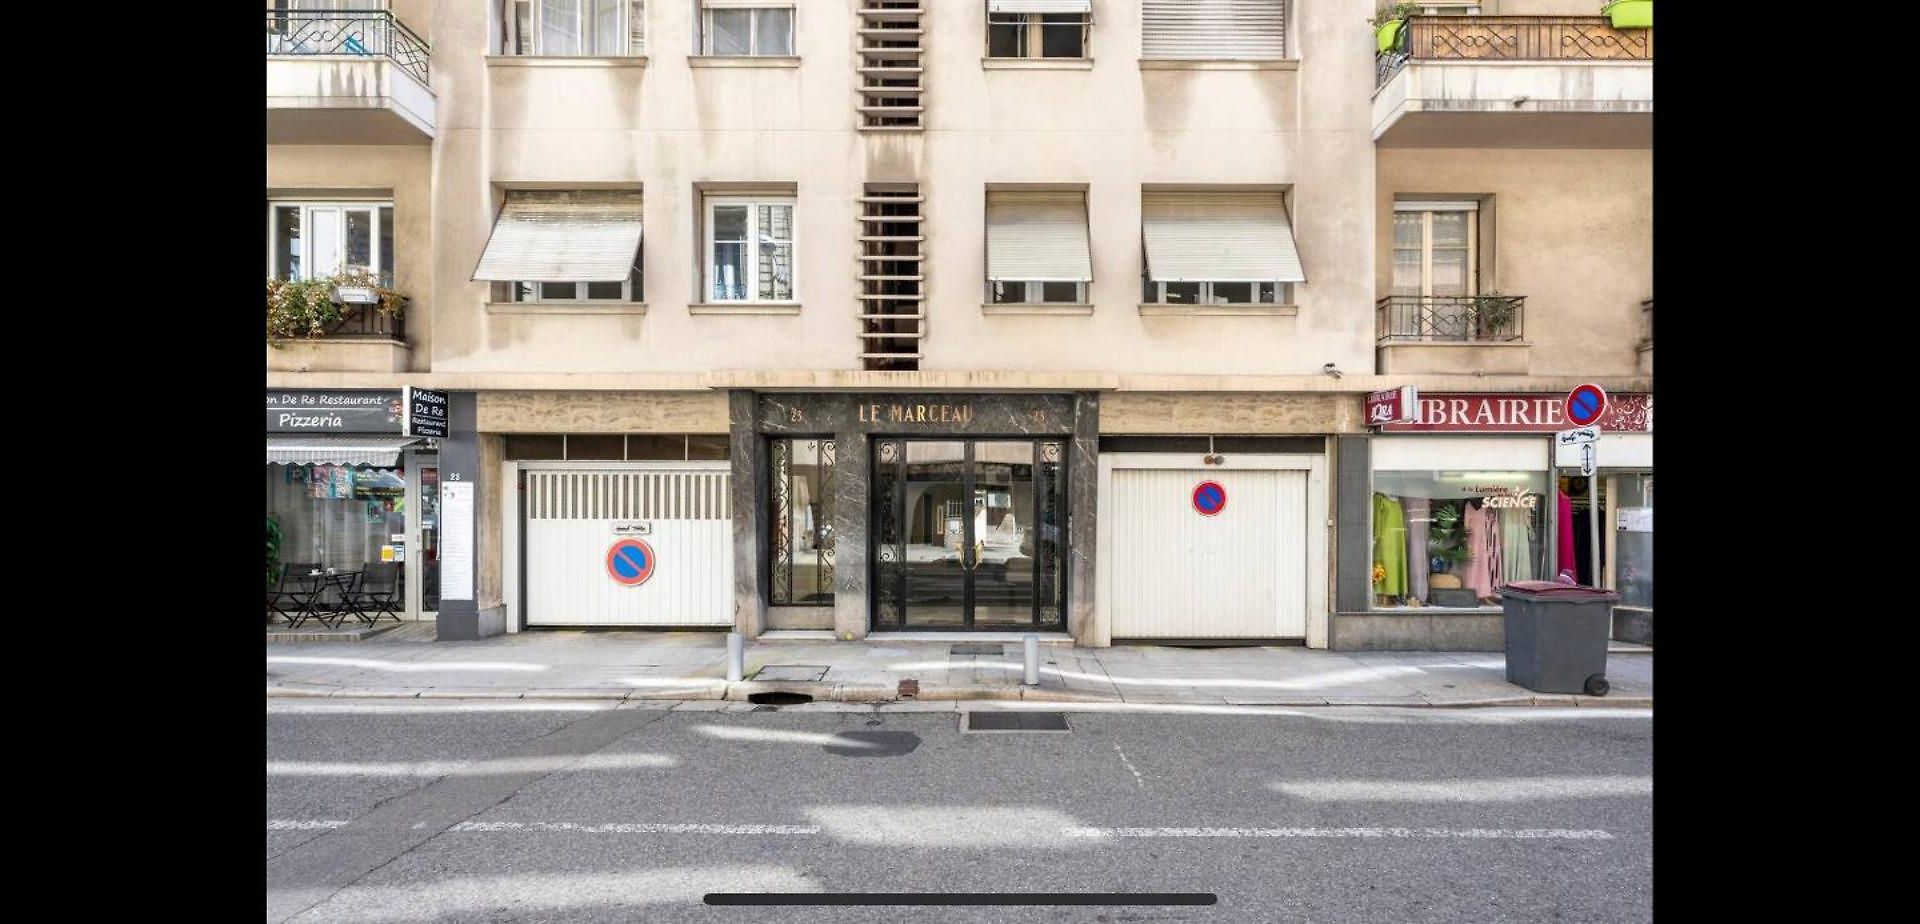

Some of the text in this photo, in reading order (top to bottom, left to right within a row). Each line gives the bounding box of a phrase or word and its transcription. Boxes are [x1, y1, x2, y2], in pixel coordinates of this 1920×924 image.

[282, 394, 297, 405] De
[301, 394, 316, 405] Re
[320, 394, 383, 405] Restaurant
[412, 390, 447, 405] Maison
[415, 403, 444, 417] De Re
[859, 404, 973, 423] LE MARCEAU
[1397, 399, 1564, 425] IBRAIRIE
[279, 412, 343, 428] Pizzeria
[411, 416, 447, 428] Restaurant
[417, 426, 442, 436] Pizzeria
[1481, 491, 1537, 508] SCIENCE
